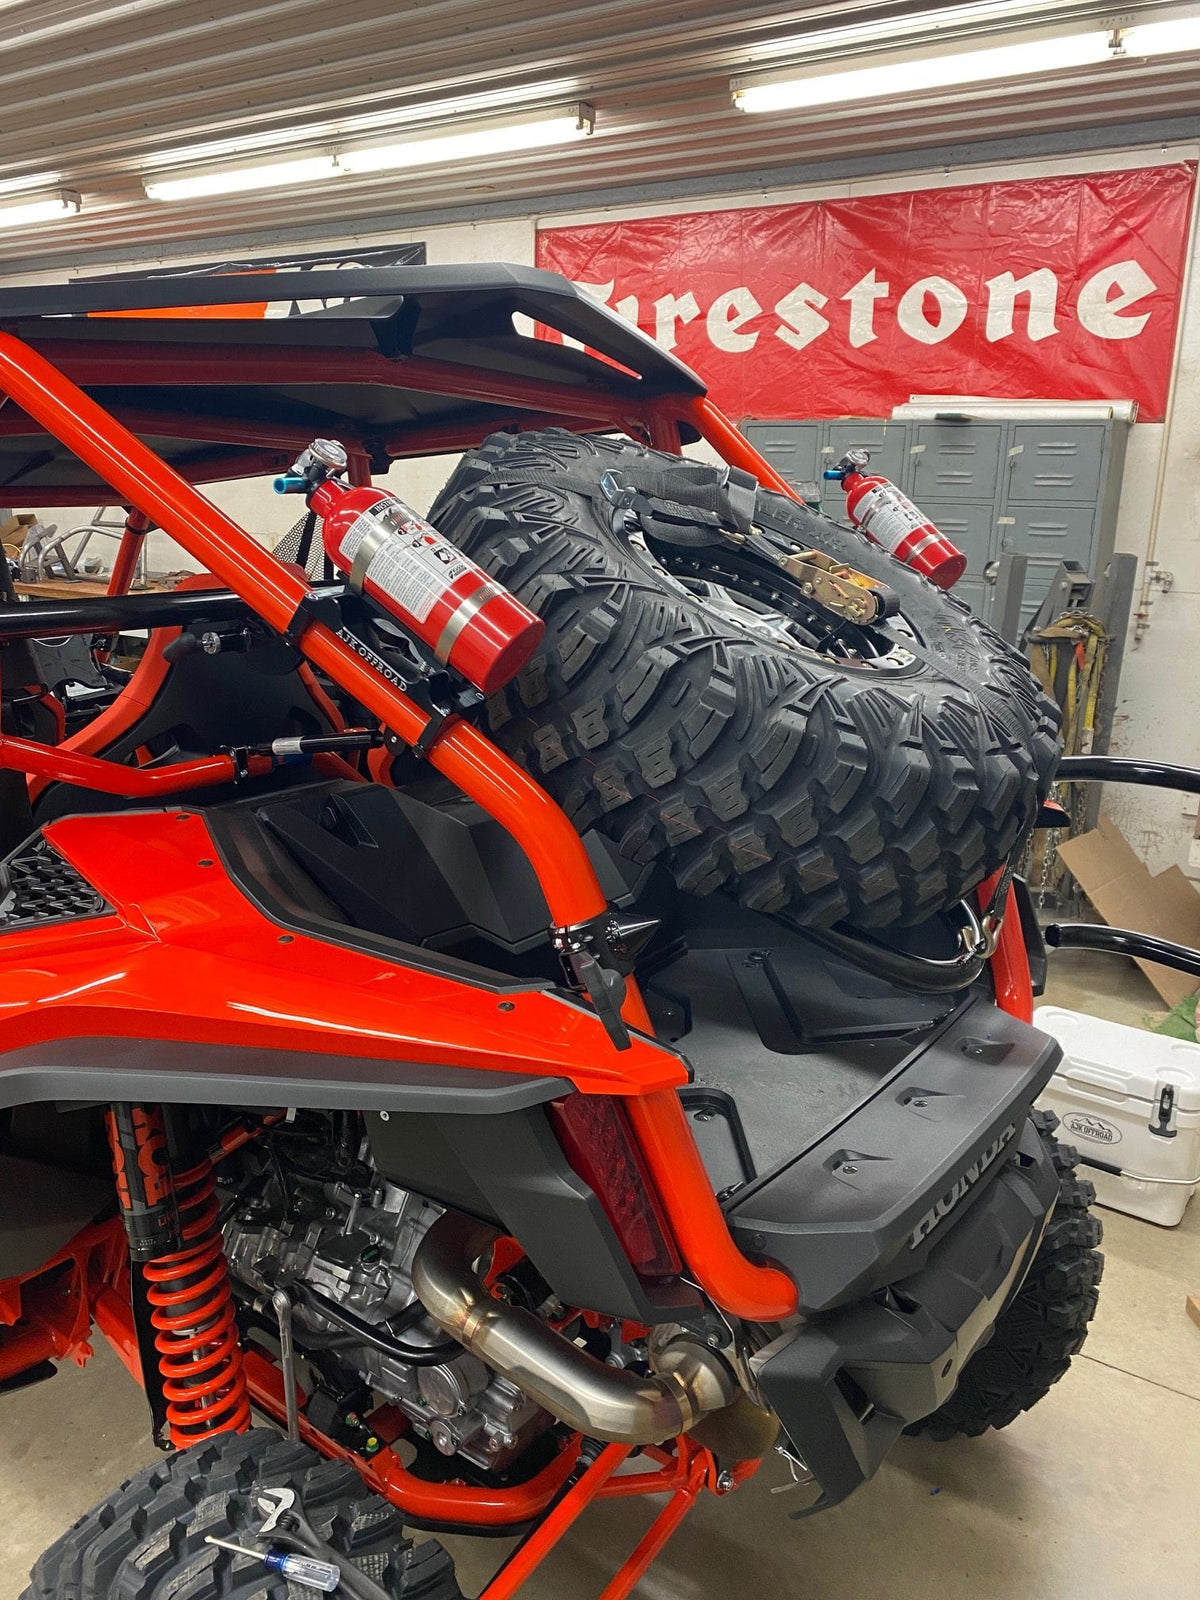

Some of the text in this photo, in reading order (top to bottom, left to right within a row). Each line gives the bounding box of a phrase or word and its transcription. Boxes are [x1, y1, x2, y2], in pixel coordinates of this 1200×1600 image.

[334, 629, 409, 692] AJK OFFROAD
[1083, 1125, 1113, 1142] OFFROAD
